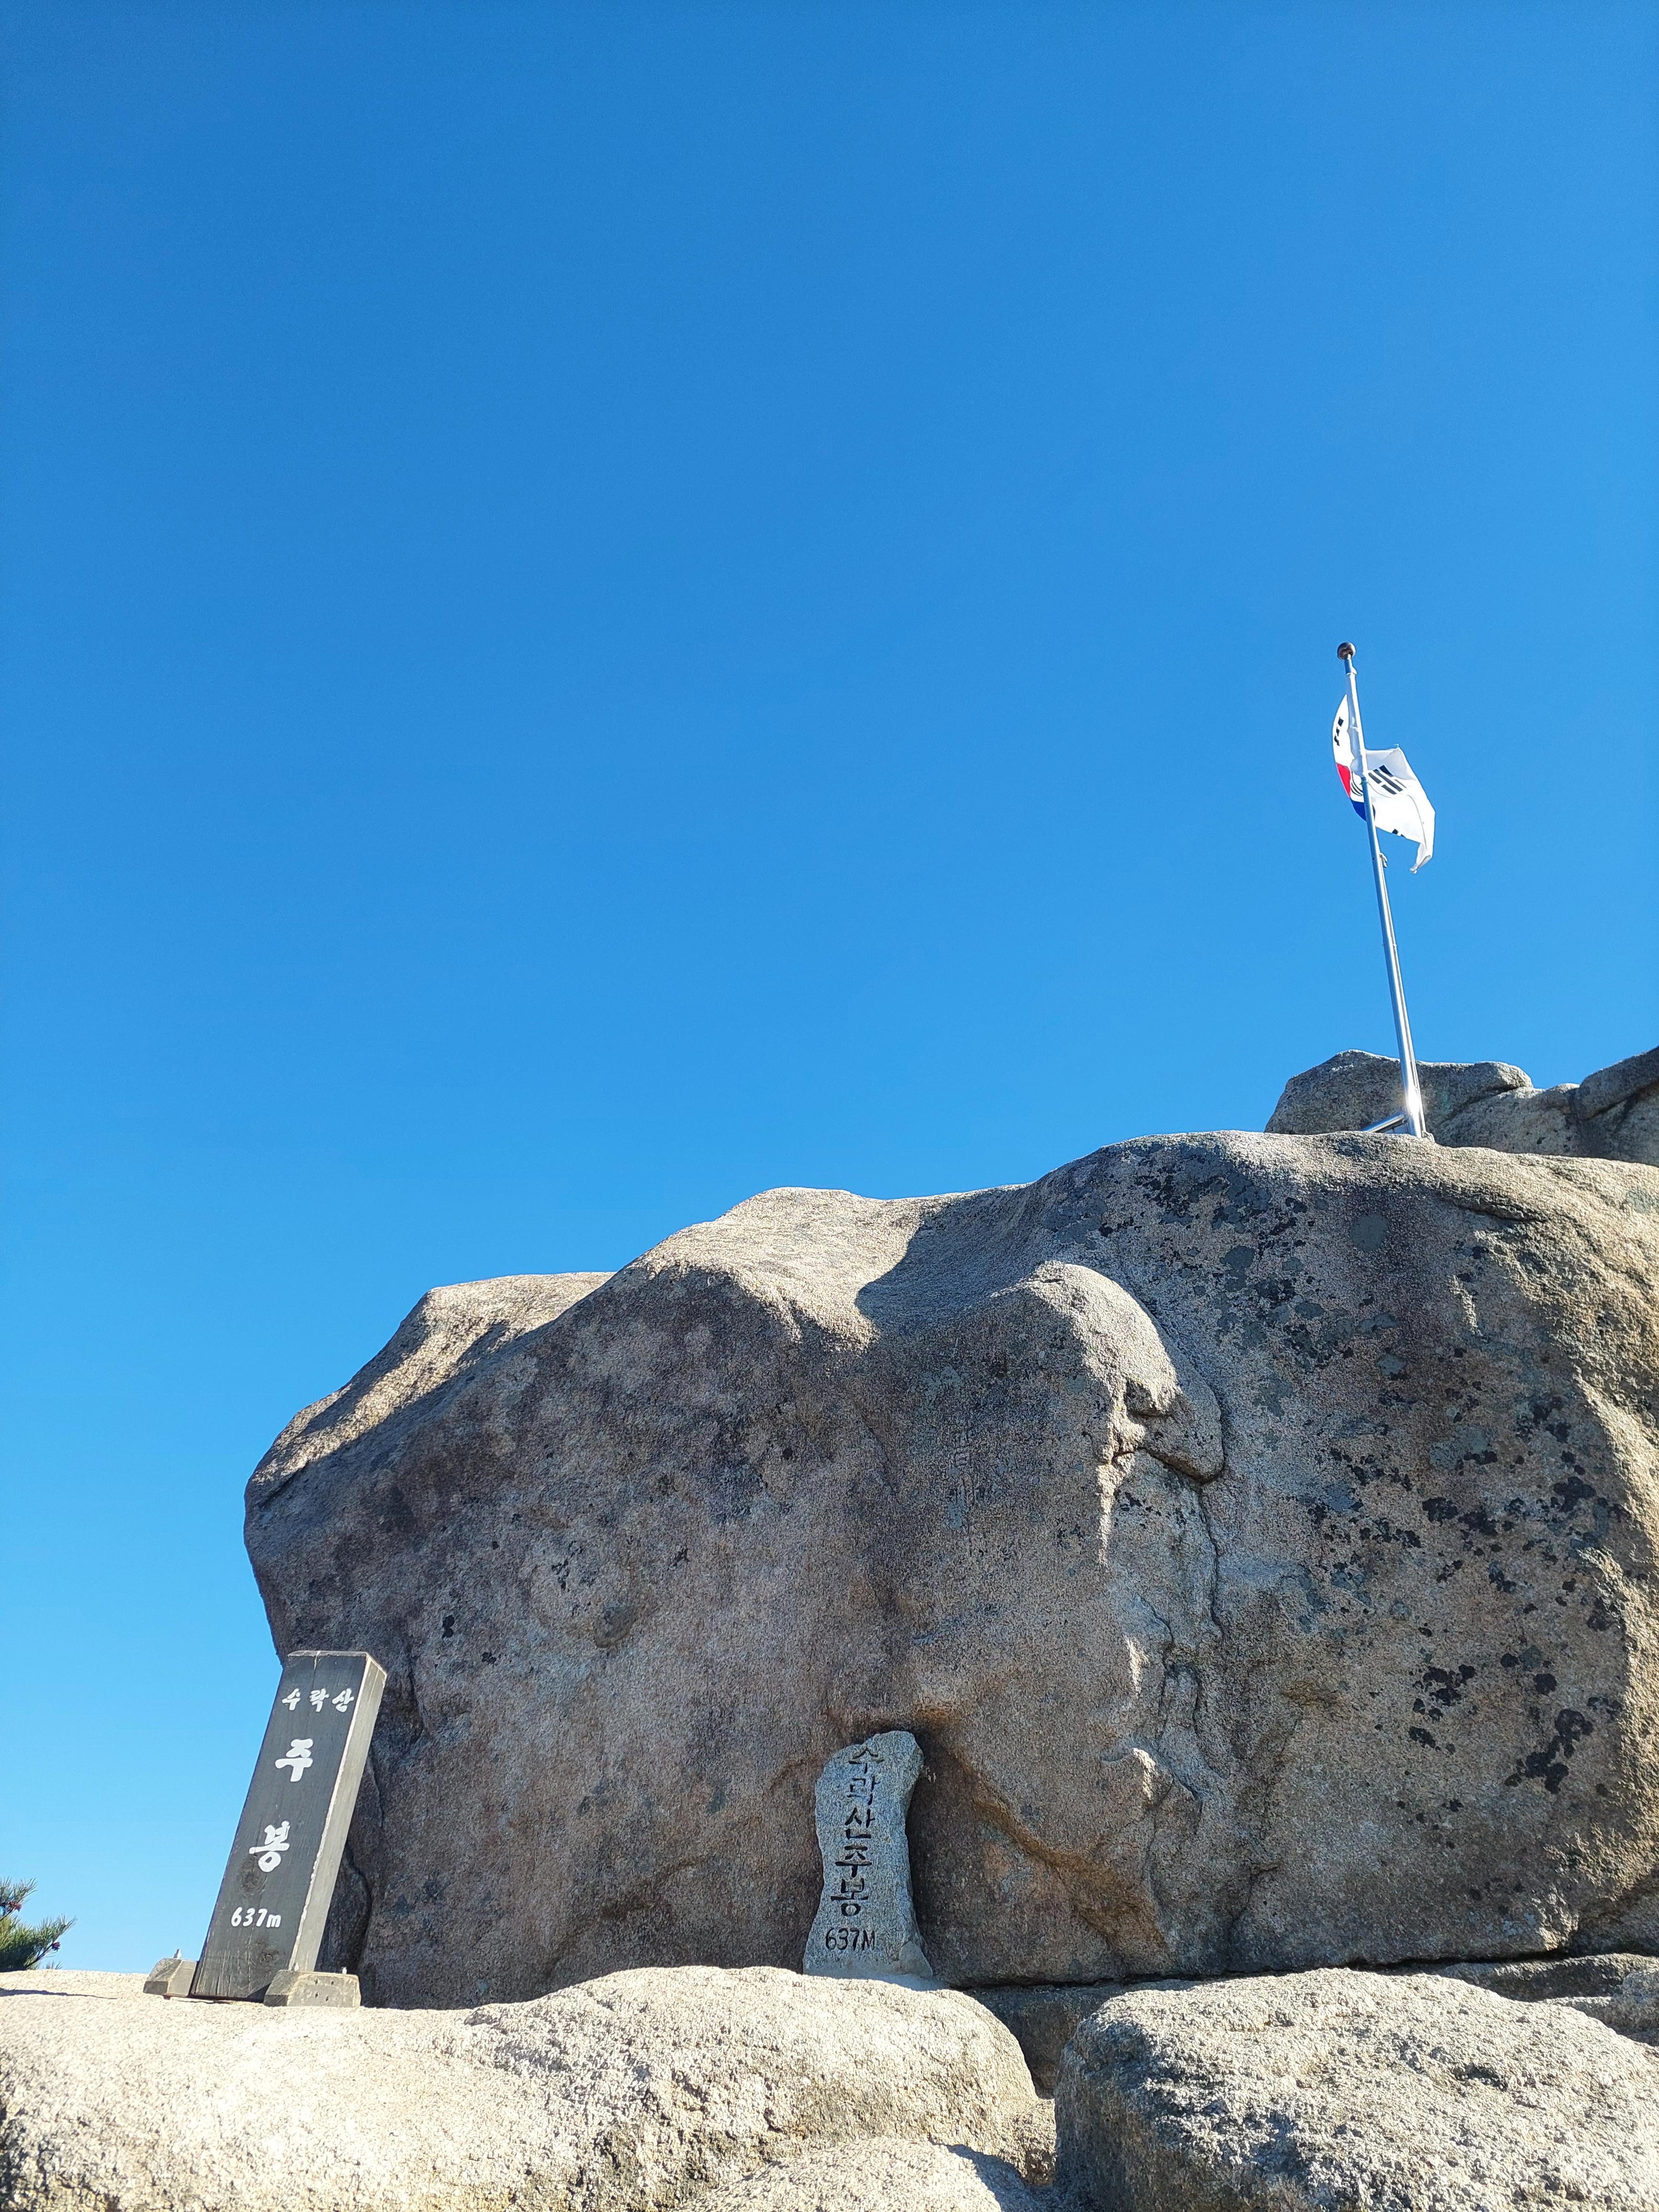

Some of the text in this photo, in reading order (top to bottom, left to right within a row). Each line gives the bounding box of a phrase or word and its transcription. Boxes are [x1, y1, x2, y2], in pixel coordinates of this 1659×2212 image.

[282, 1688, 354, 1712] 수락산
[231, 1906, 282, 1928] 637m
[825, 1927, 875, 1951] 637M
